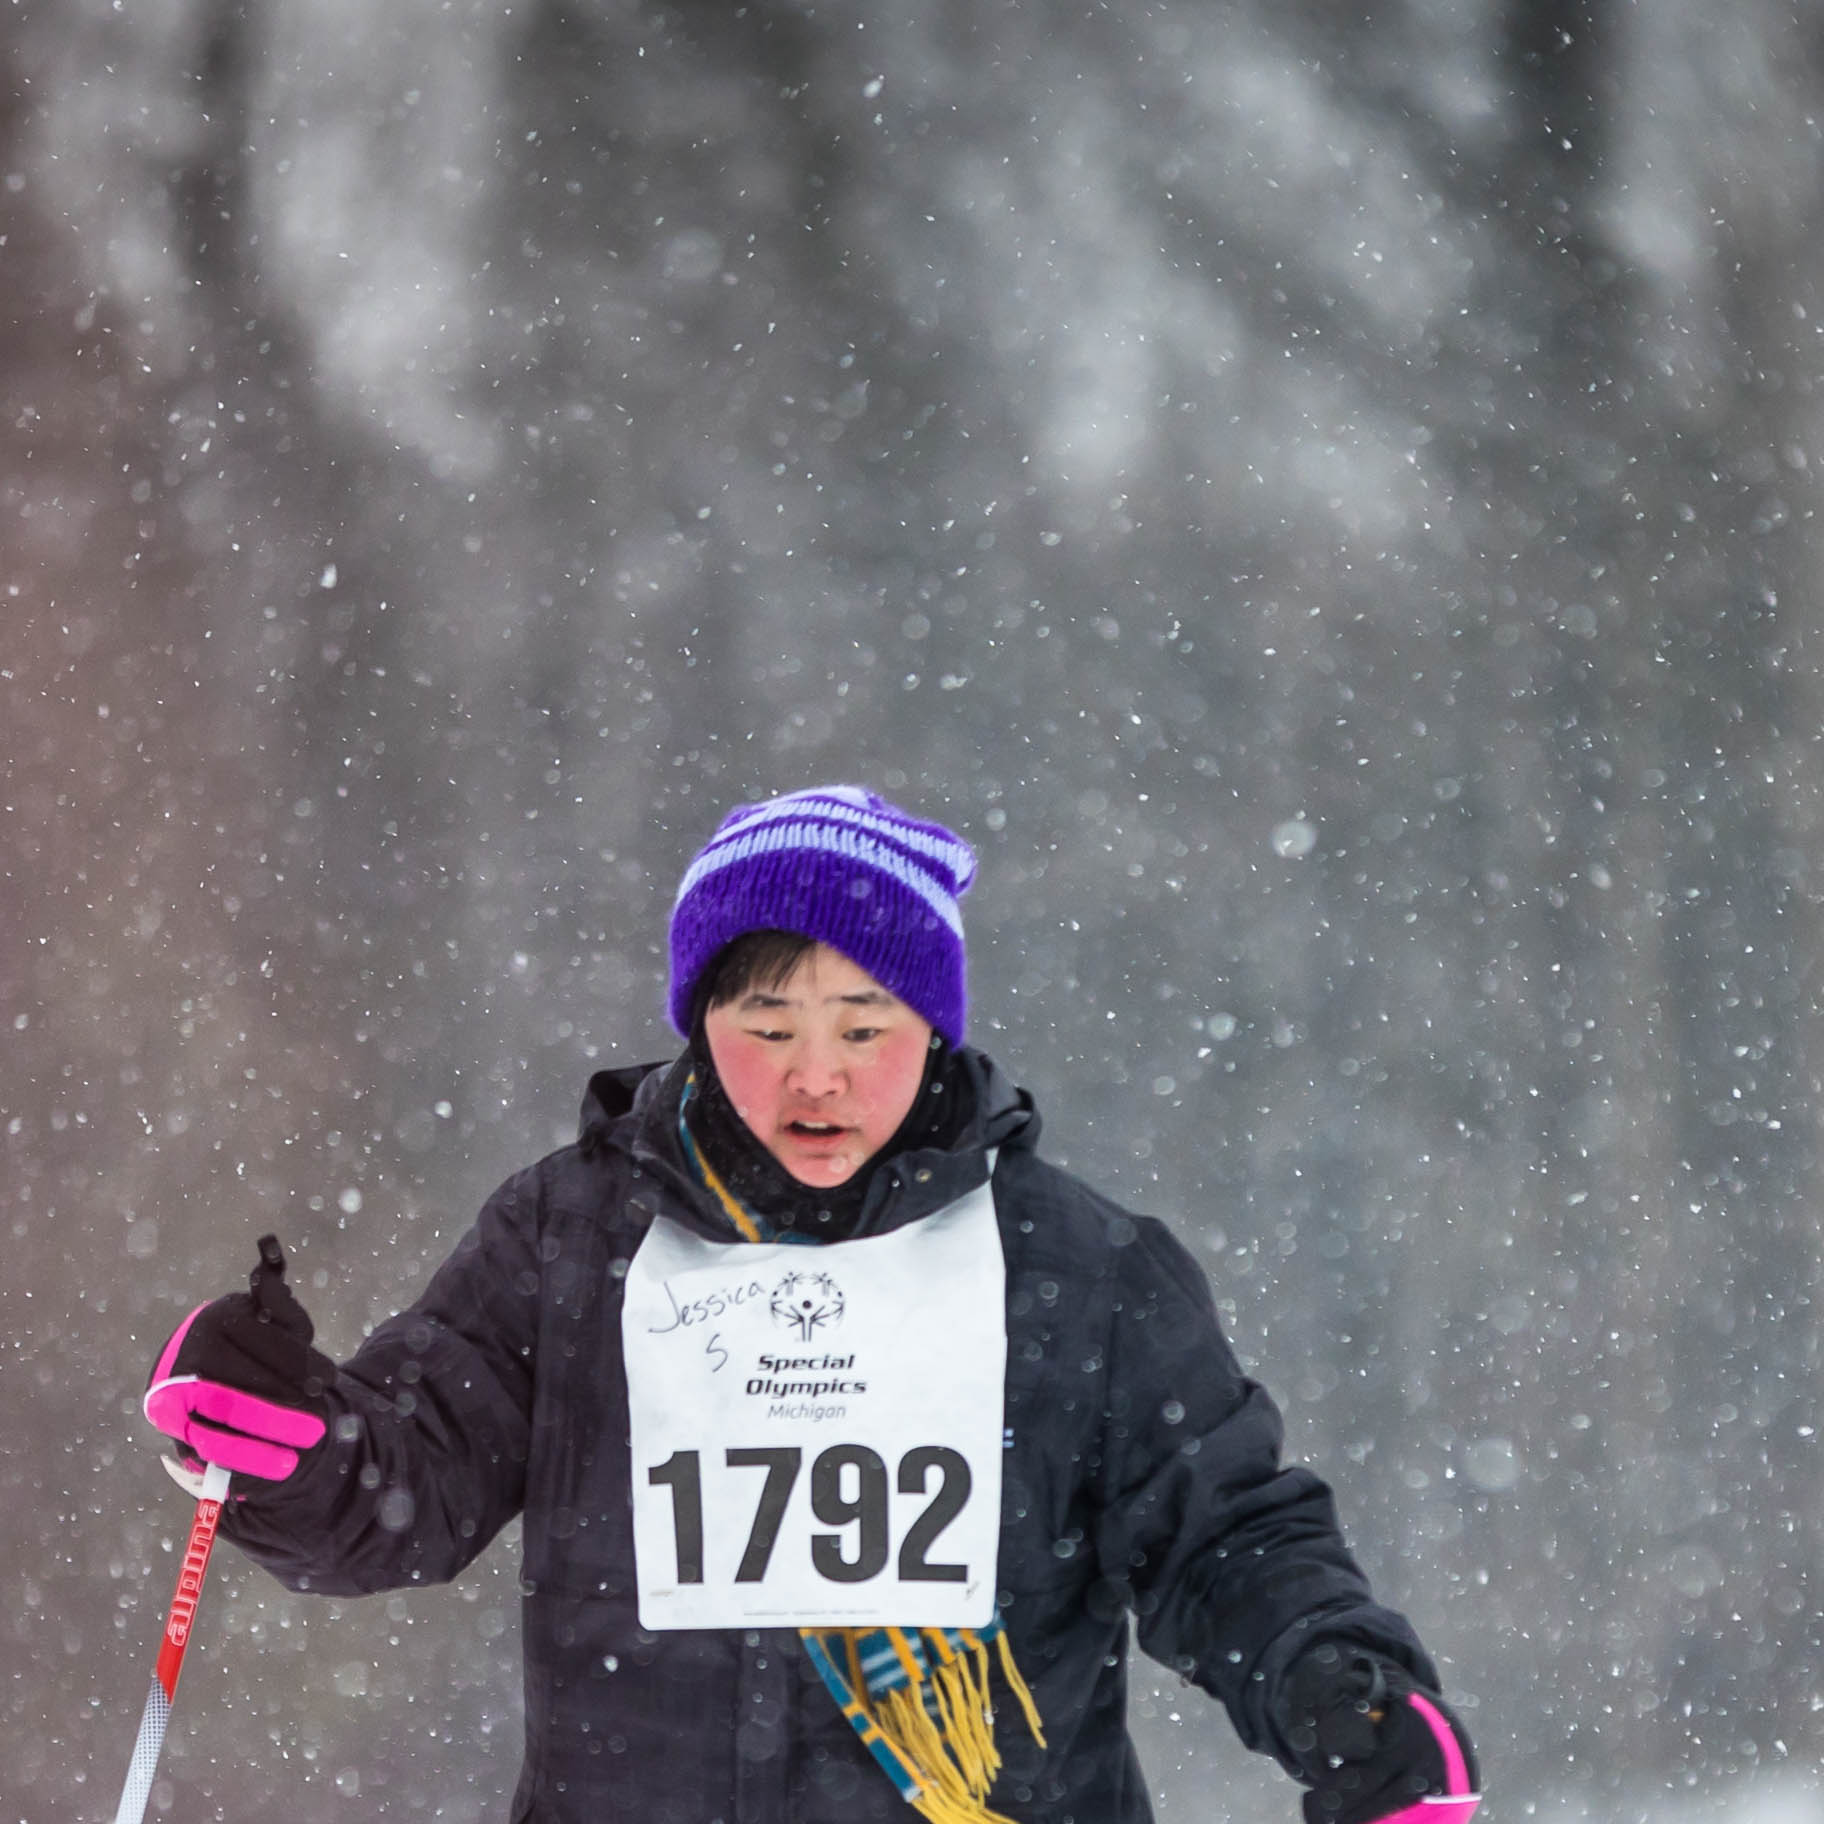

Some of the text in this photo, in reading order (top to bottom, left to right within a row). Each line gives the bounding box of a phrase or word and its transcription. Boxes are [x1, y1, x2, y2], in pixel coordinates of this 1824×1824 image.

[648, 1281, 766, 1333] Jessica
[757, 1354, 856, 1374] Special
[745, 1379, 867, 1399] Olympics
[767, 1403, 846, 1423] Michigan
[648, 1444, 972, 1584] 1792
[167, 1503, 221, 1646] alpina
